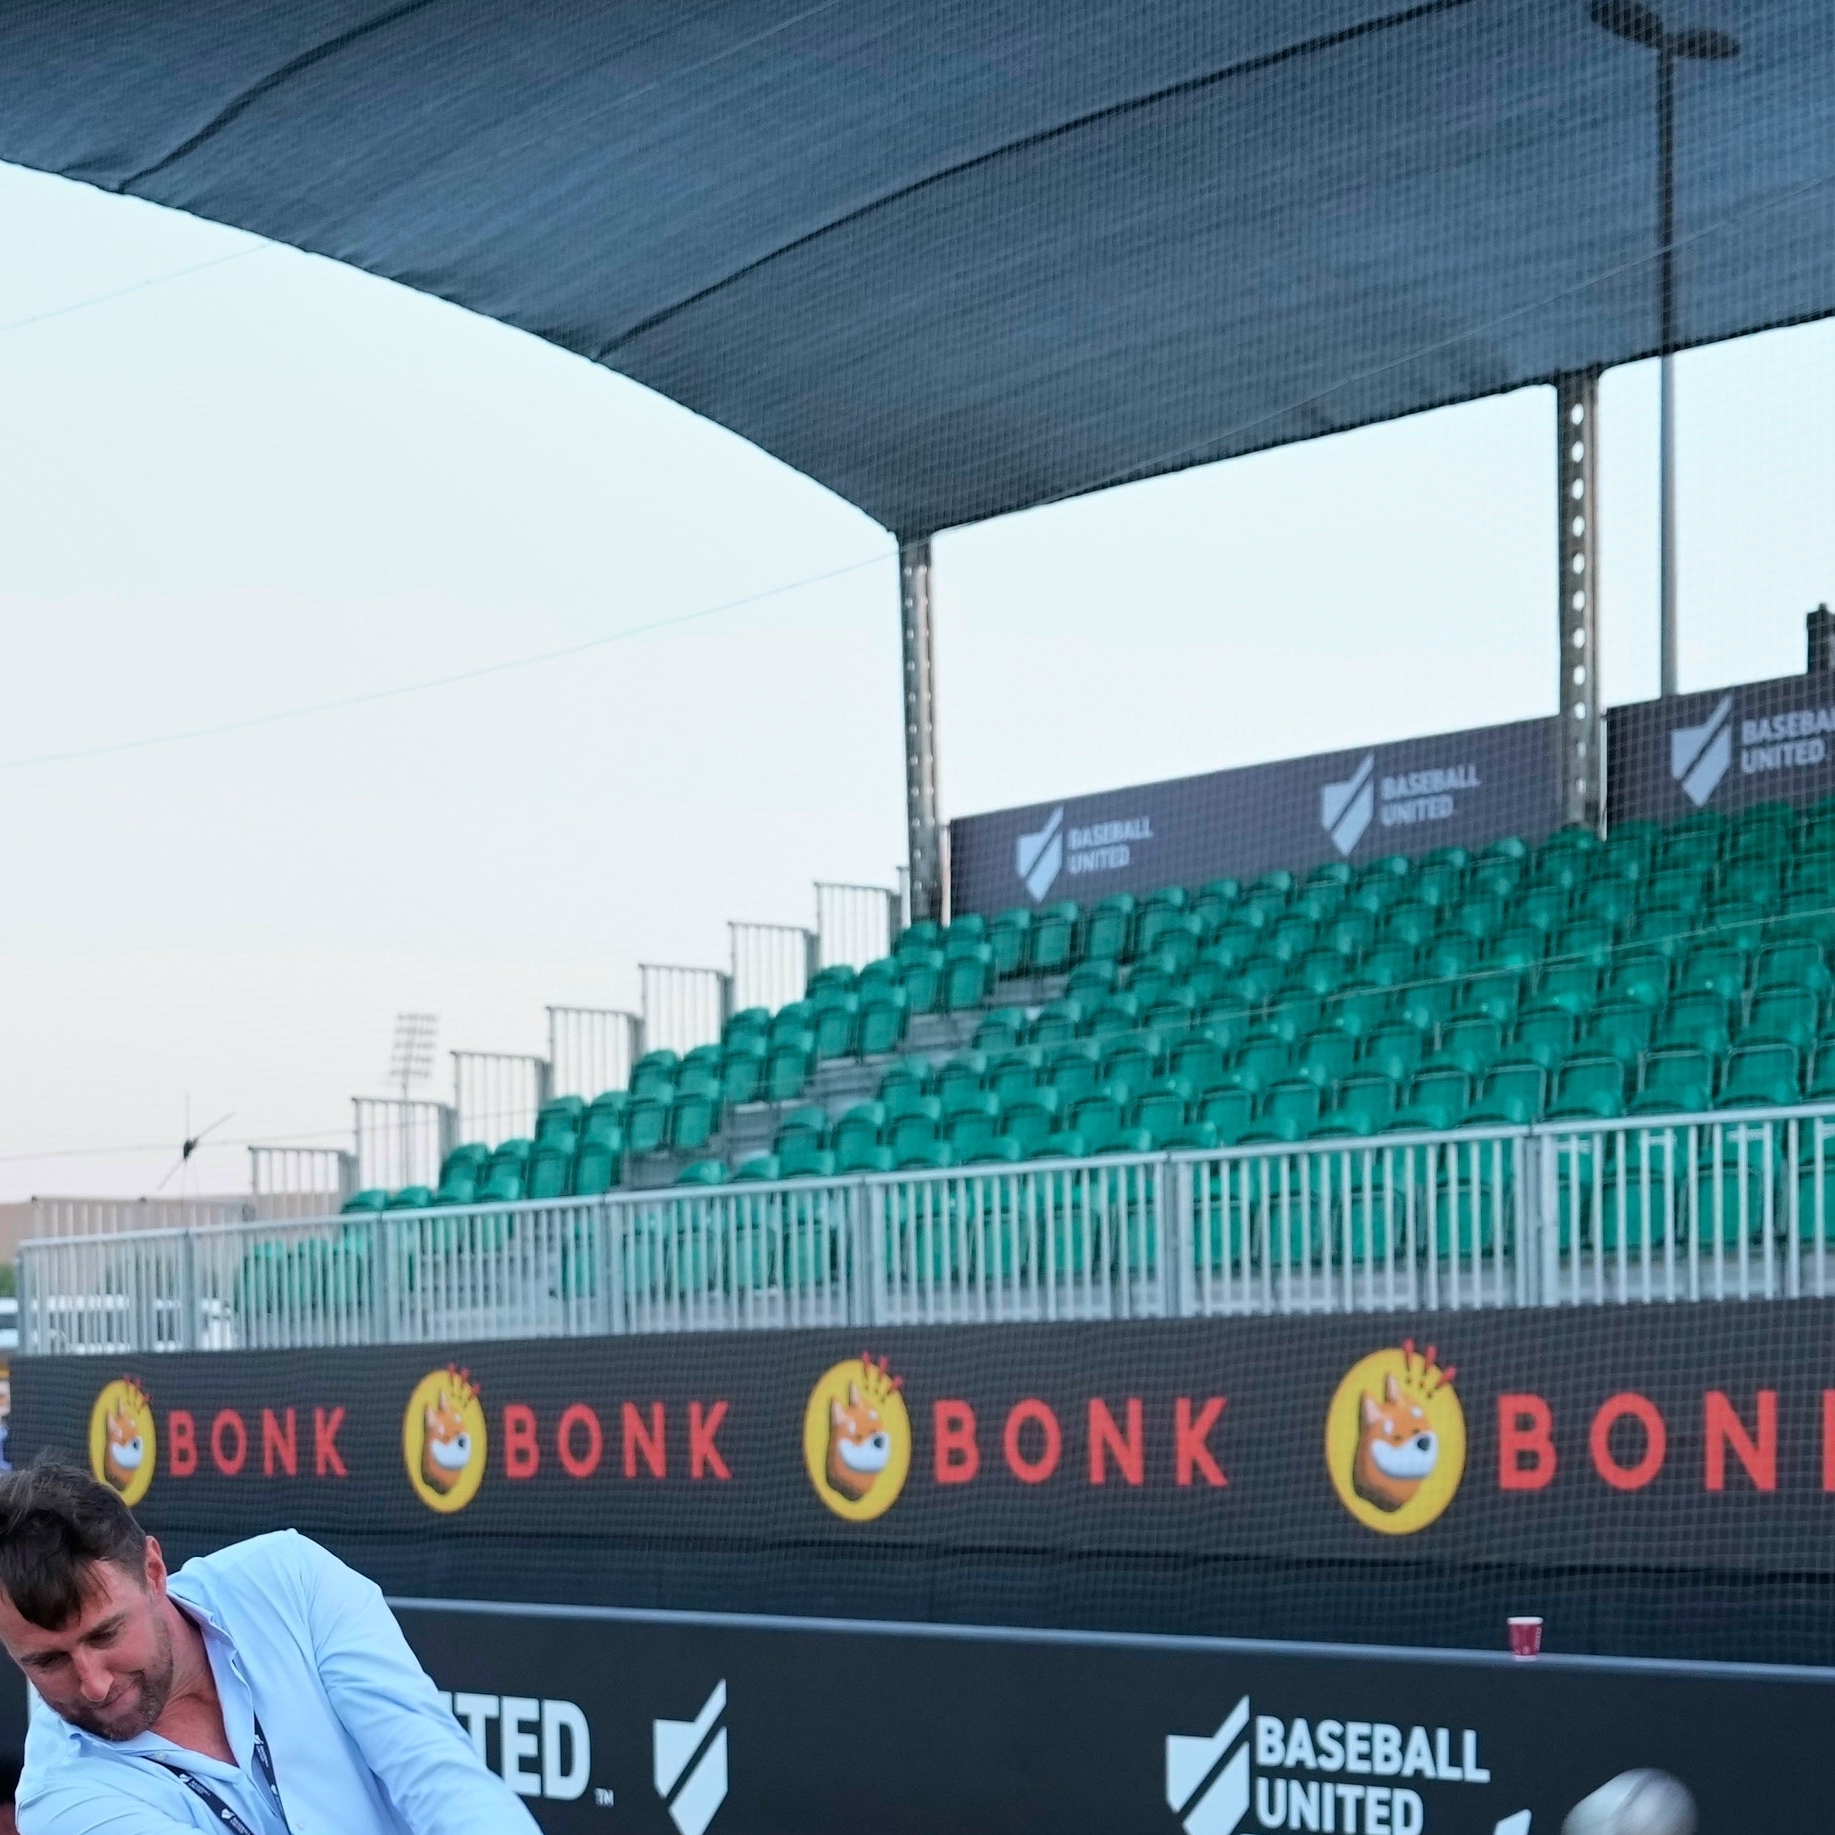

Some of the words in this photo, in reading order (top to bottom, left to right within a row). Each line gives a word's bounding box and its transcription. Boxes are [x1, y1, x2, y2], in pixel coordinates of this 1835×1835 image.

[1380, 763, 1482, 800] BASEBALL
[1741, 740, 1826, 775] UNITED
[1068, 816, 1153, 851] BASEBALL
[1380, 795, 1454, 826] UNITED
[1068, 845, 1130, 874] UNITED
[168, 1405, 348, 1478] BONK
[502, 1400, 731, 1481] BONK
[931, 1396, 1229, 1488] BONK
[437, 1690, 592, 1801] TED
[1255, 1714, 1491, 1784] BASEBALL
